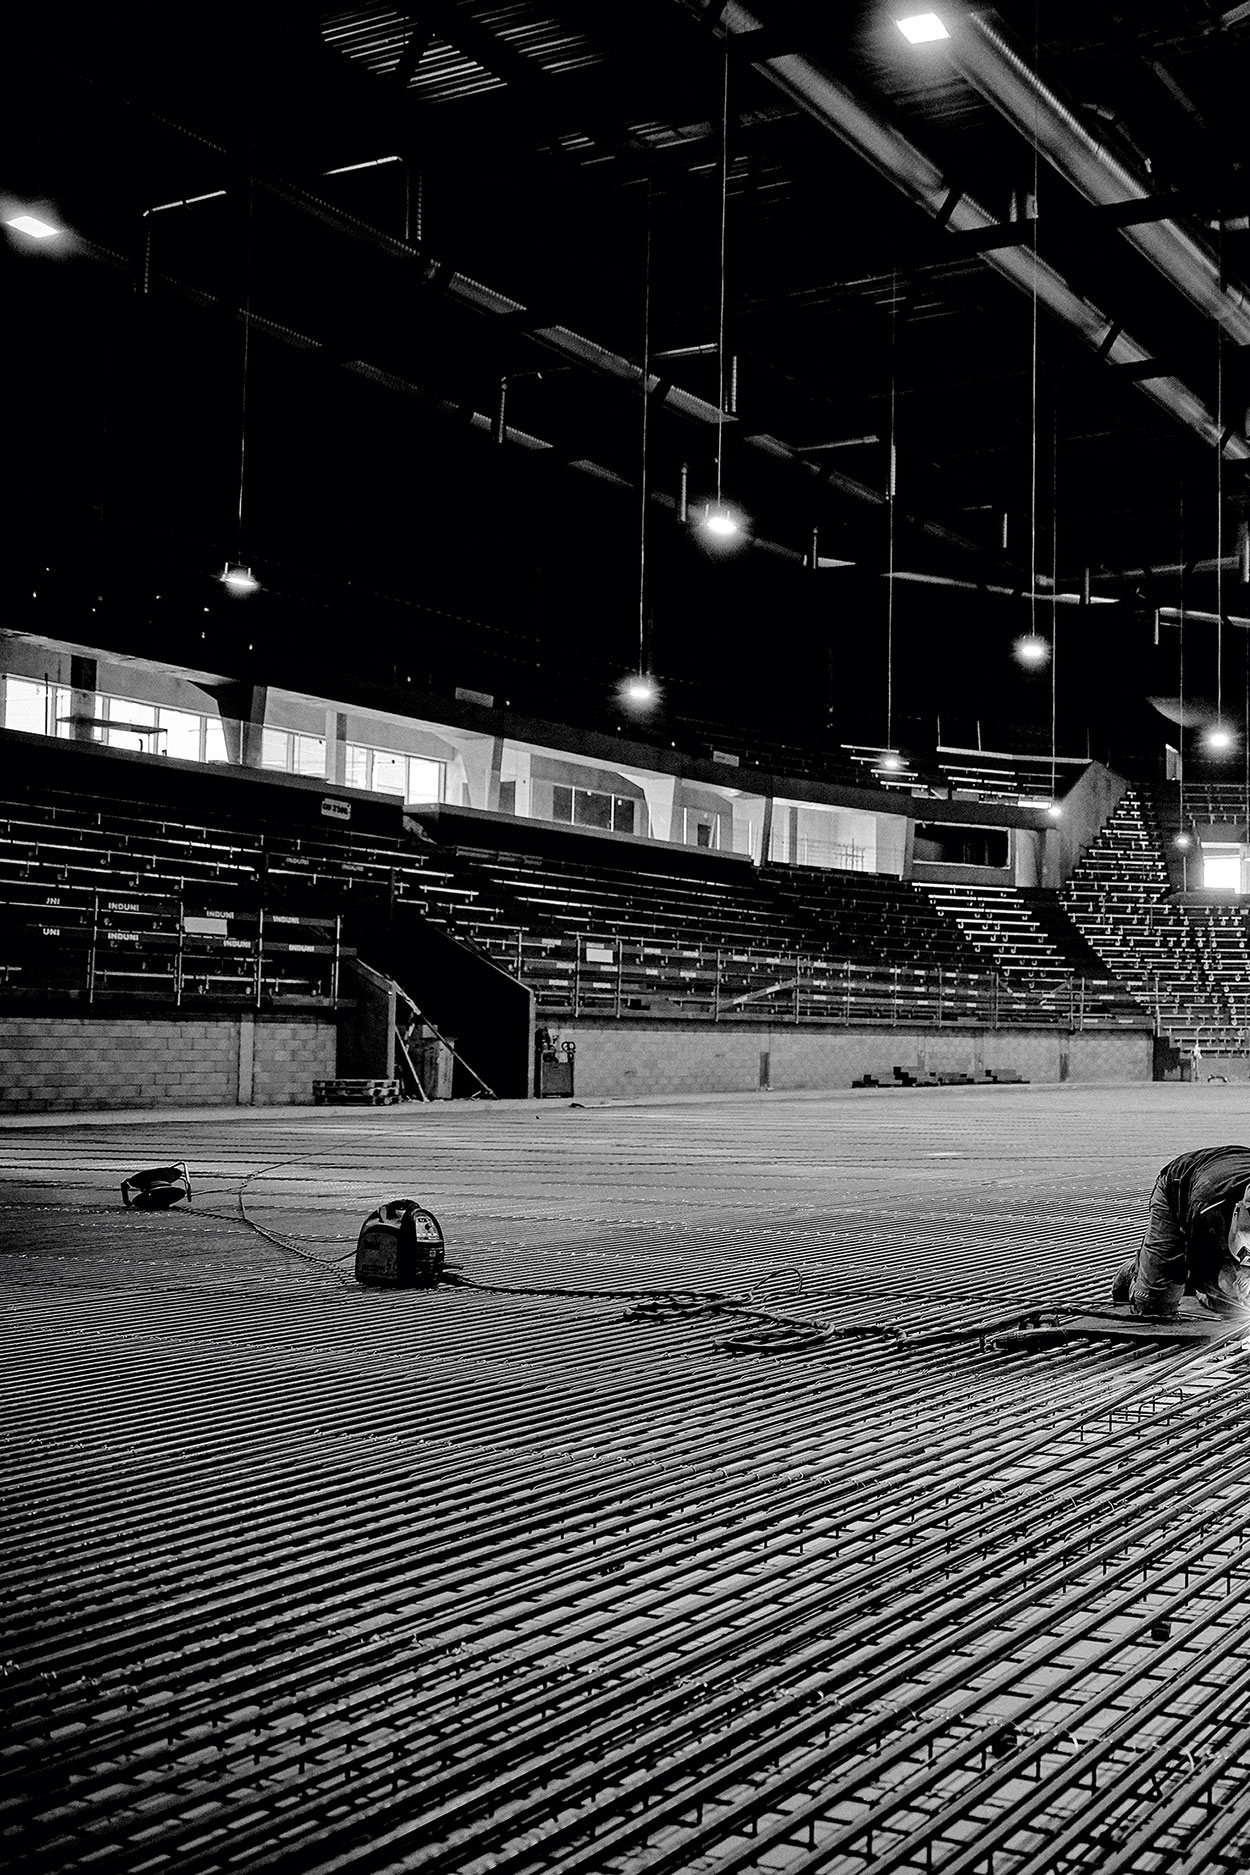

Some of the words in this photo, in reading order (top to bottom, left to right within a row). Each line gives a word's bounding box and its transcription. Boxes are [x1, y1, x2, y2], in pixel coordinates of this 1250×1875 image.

[108, 902, 140, 911] INDUNI
[206, 910, 234, 919] INDUNI
[107, 932, 139, 941] INDUNI
